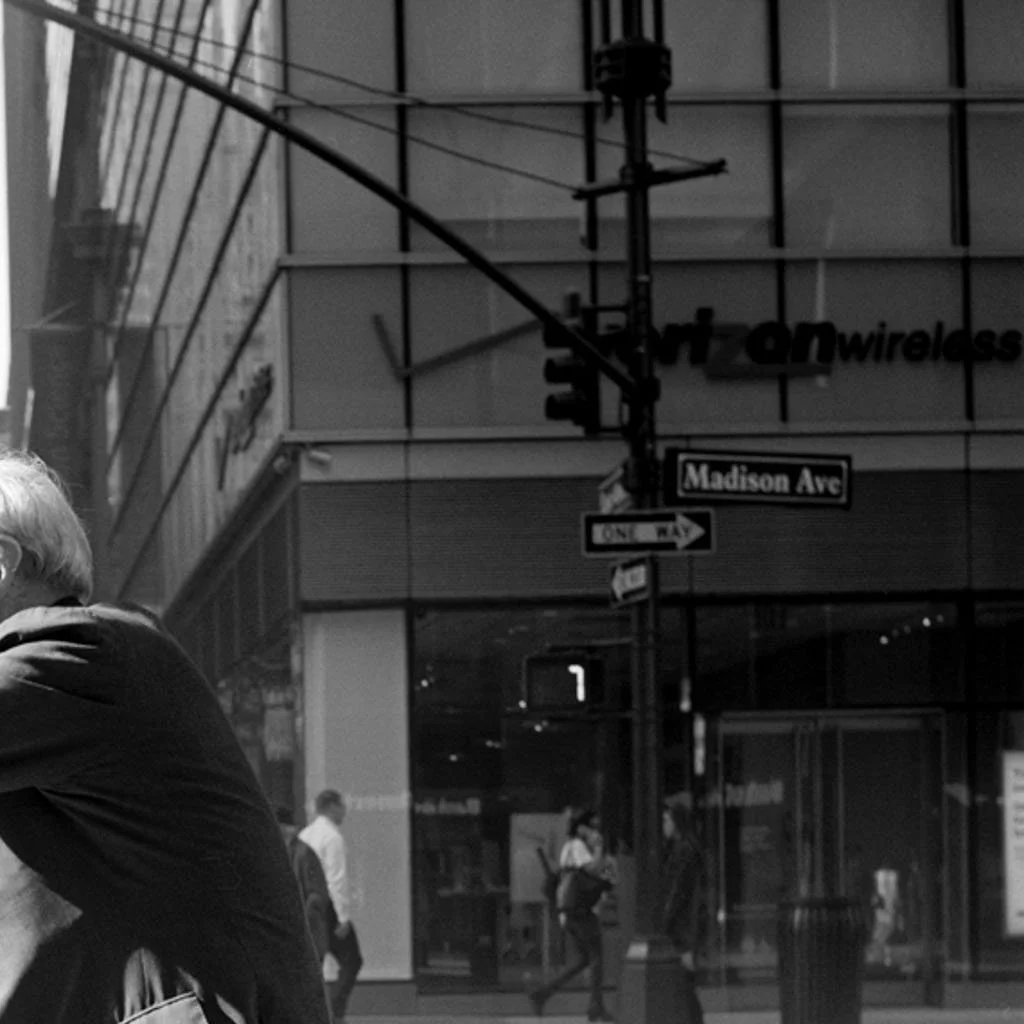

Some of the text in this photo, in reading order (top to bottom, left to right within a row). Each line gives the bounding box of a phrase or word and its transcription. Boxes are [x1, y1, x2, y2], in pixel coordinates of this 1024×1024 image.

[838, 318, 1022, 364] wireless
[682, 462, 843, 495] Madison Ave
[656, 521, 692, 541] WAY
